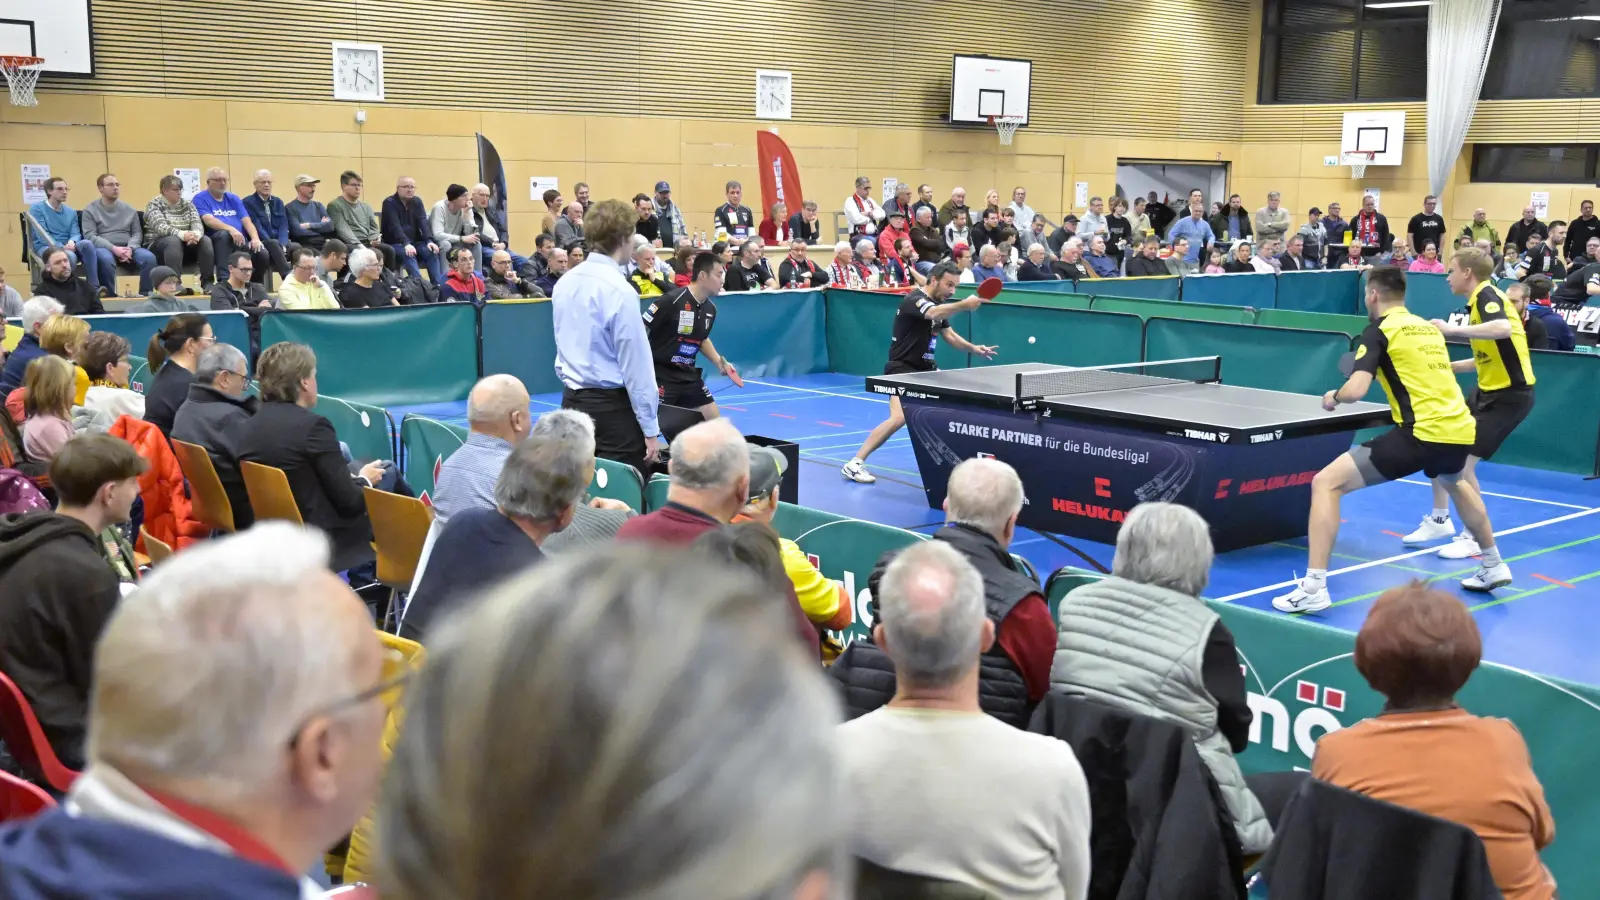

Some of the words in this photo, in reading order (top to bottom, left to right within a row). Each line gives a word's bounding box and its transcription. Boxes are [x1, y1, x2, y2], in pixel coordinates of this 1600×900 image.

[874, 385, 896, 395] TIBHAR
[1184, 429, 1217, 442] TIBHAR
[1250, 431, 1274, 444] TIBHAR
[949, 422, 989, 438] STARKE
[992, 428, 1042, 447] PARTNER
[1045, 436, 1061, 450] für
[1064, 439, 1080, 453] die
[1083, 442, 1150, 465] Bundesliga!
[1052, 497, 1129, 523] HELUKA
